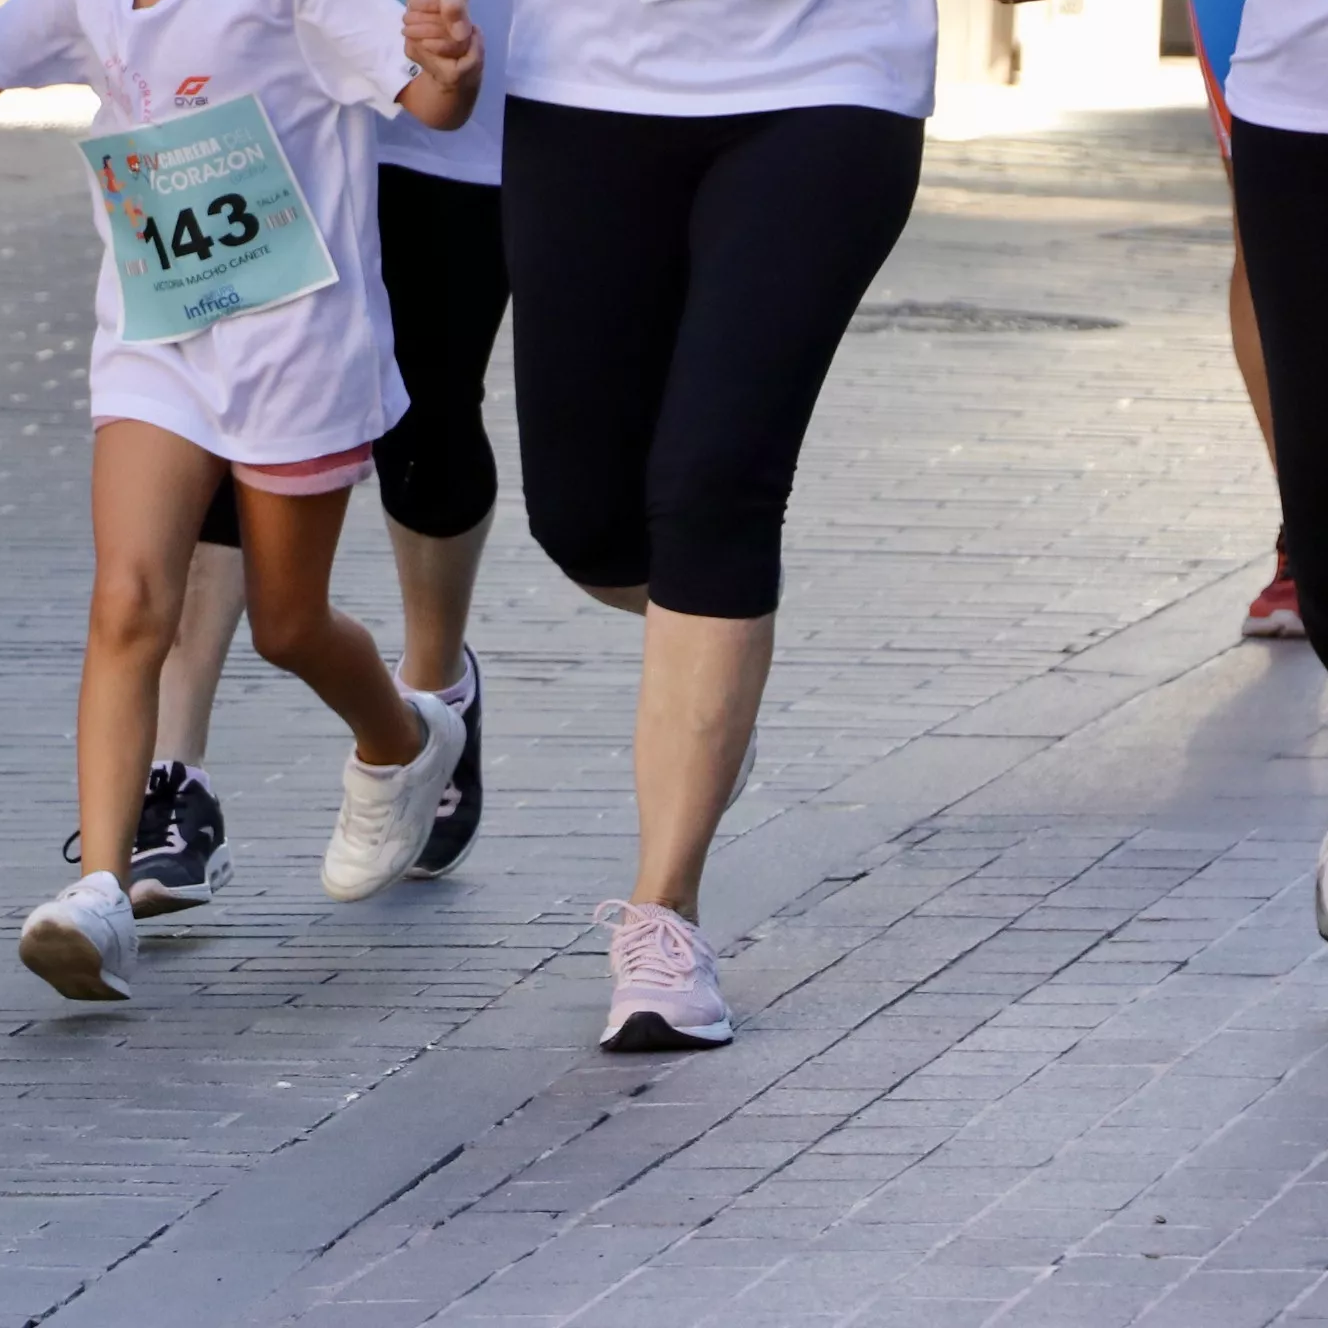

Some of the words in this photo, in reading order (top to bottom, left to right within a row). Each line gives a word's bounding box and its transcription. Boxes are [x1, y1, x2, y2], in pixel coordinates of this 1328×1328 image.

[158, 137, 222, 170] CARRERA
[143, 192, 260, 271] 143
[185, 263, 227, 286] MACHO
[183, 291, 241, 320] Infrico
